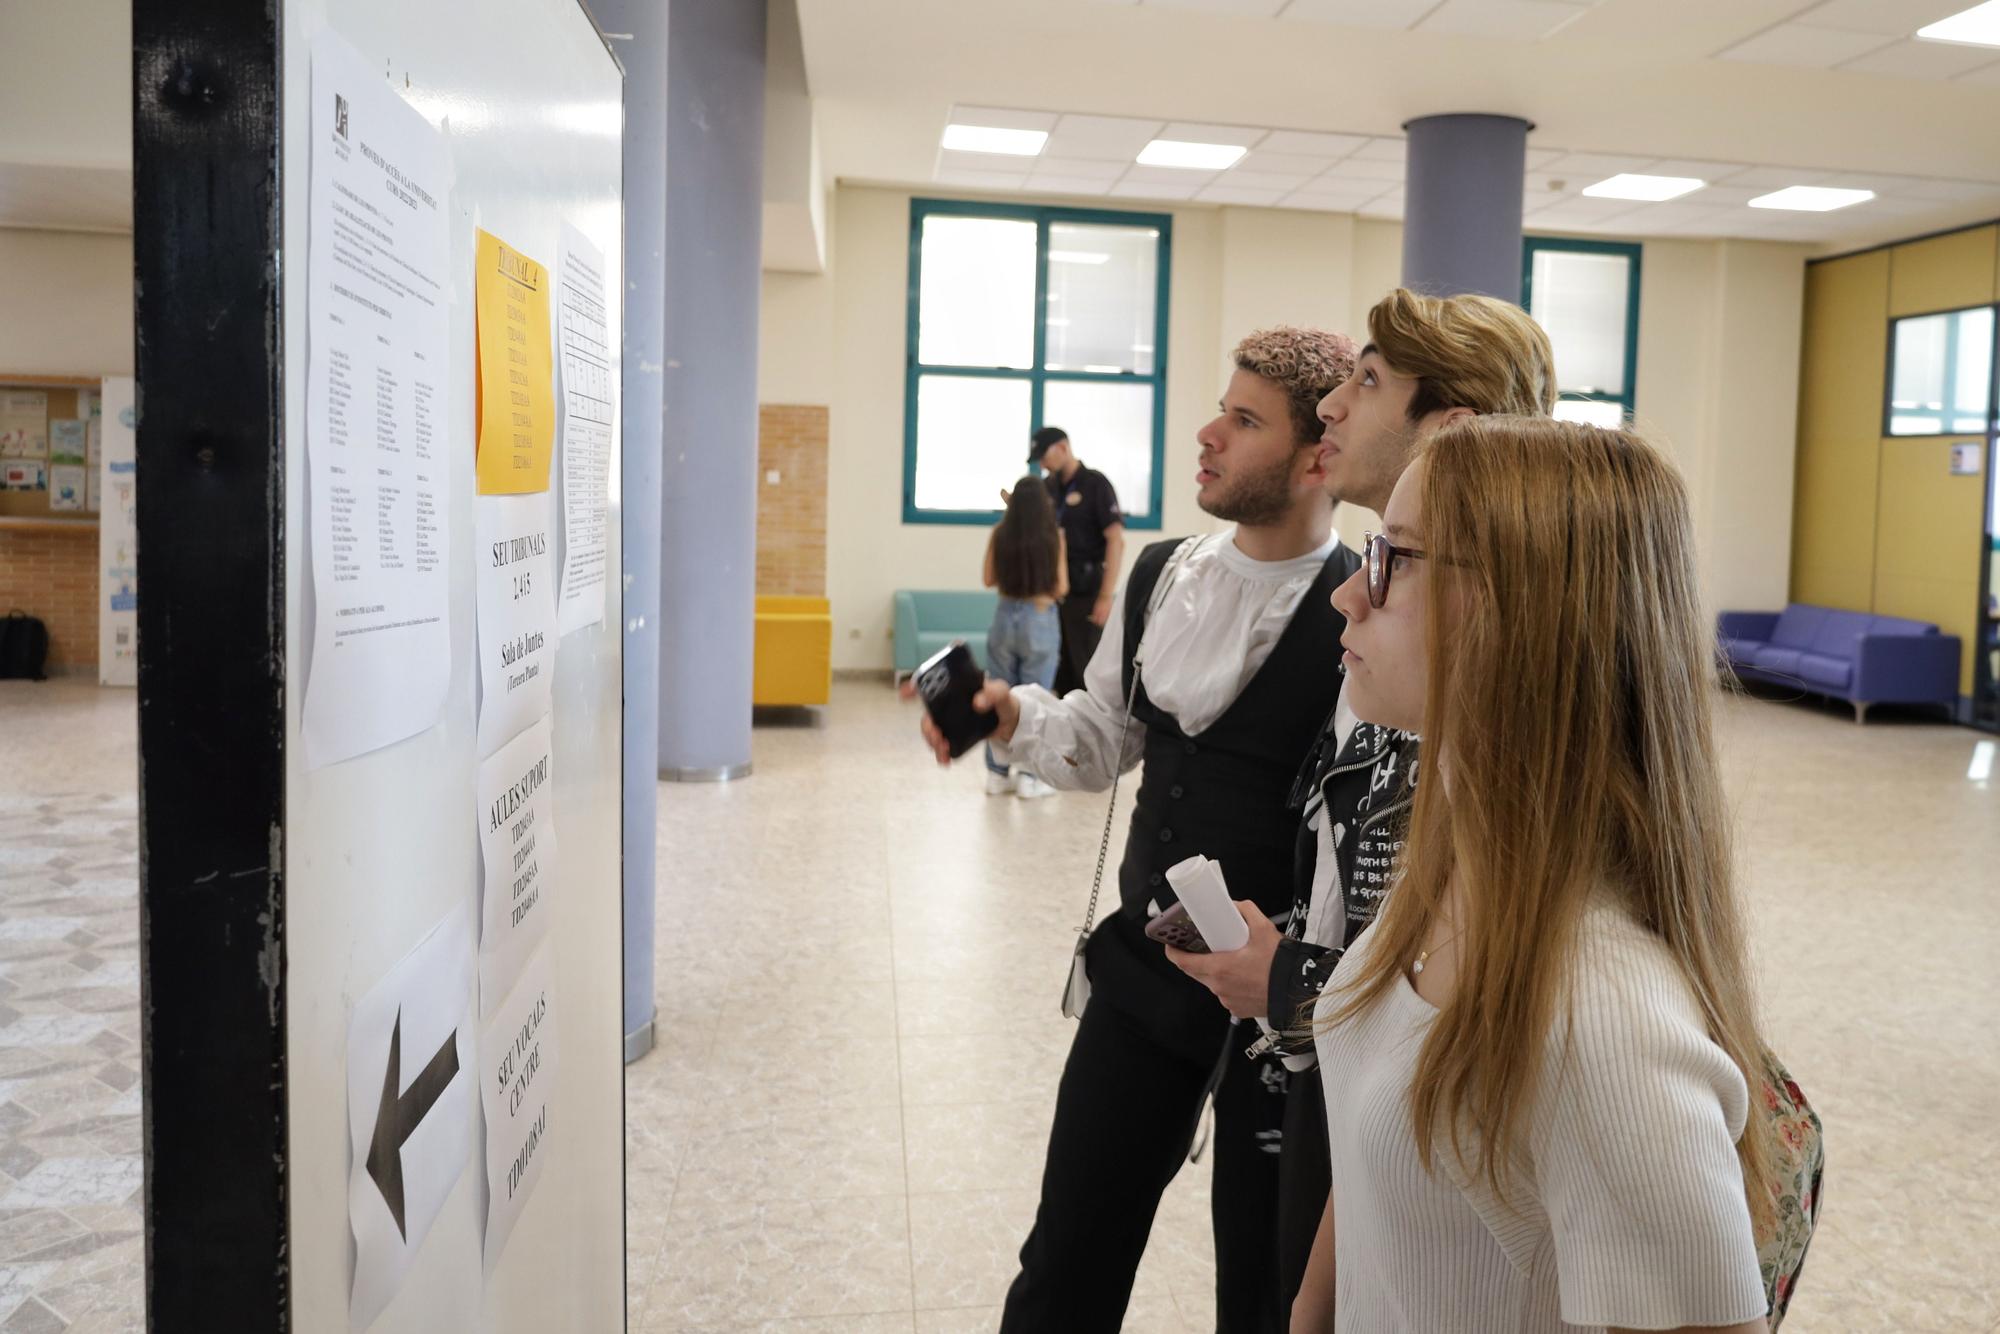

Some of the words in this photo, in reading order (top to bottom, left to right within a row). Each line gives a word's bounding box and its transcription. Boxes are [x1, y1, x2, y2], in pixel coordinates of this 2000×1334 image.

[360, 141, 380, 166] PROVES
[411, 181, 437, 211] UNIVERSITAT
[492, 541, 510, 568] SEU
[510, 532, 546, 563] TRIBUNALS
[502, 641, 515, 668] Sala
[517, 636, 524, 660] de
[525, 631, 544, 655] Juntes
[507, 672, 525, 694] (Tercera
[490, 783, 520, 834] AULES
[521, 754, 548, 804] SUPORT
[498, 1045, 515, 1095] SEU
[516, 991, 546, 1059] VOCALS
[510, 1041, 541, 1117] CENTRE
